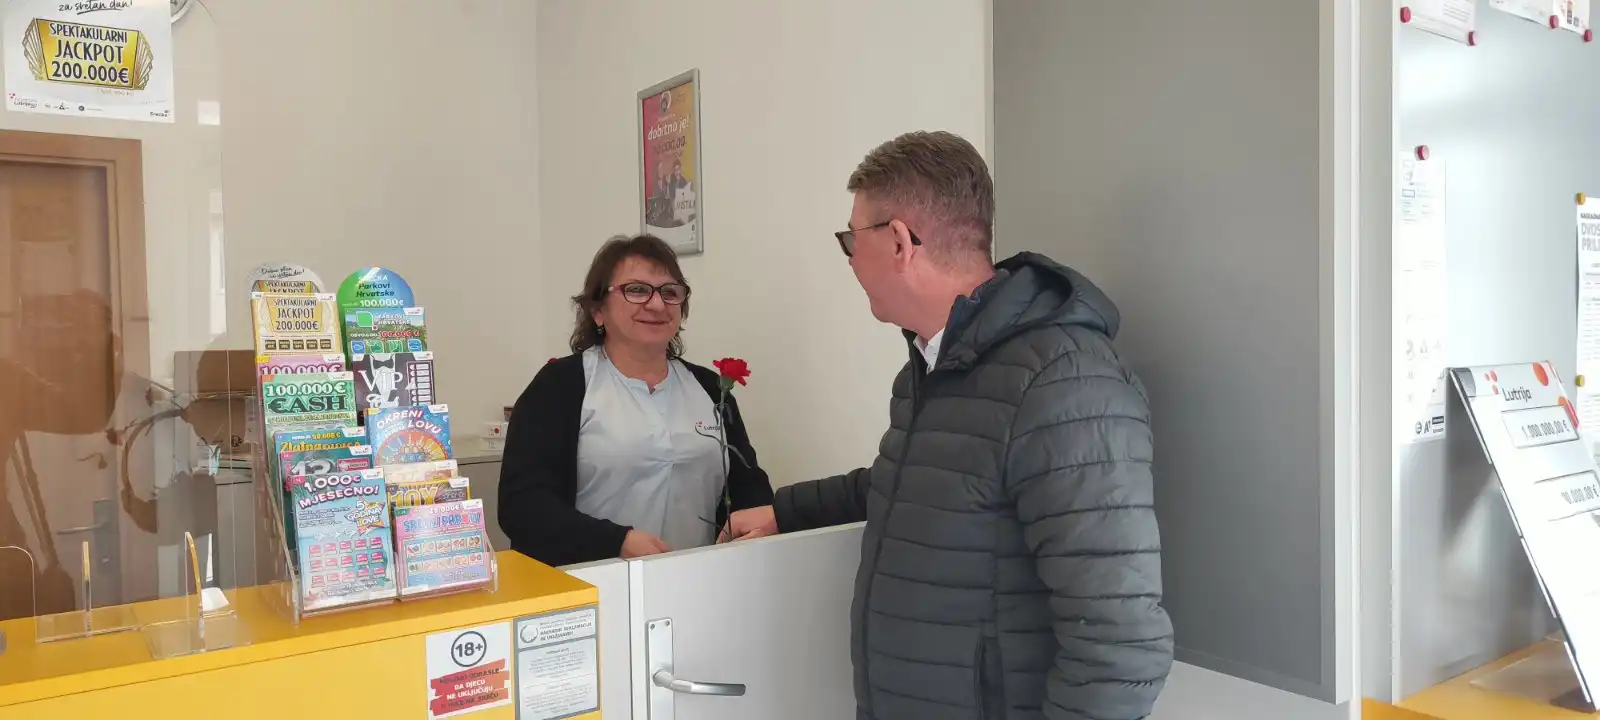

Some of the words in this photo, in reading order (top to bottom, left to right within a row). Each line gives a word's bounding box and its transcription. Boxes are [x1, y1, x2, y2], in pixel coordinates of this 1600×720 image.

[75, 0, 106, 10] sretan
[50, 22, 128, 43] SPEKTAKULARNI
[54, 41, 124, 64] JACKPOT
[51, 61, 129, 84] 200.000€
[648, 122, 678, 141] dobitno
[359, 281, 391, 290] Parkovi
[356, 290, 395, 298] Hrvatske
[360, 298, 404, 307] 100.000€
[277, 307, 315, 319] JACKPOT
[276, 320, 319, 331] 200.000€
[358, 370, 404, 392] VIP
[266, 381, 346, 397] 100.000€
[1501, 386, 1532, 403] Lutrija
[376, 409, 424, 430] OKRENI
[407, 419, 442, 434] LOVU
[356, 501, 365, 511] 5
[455, 641, 484, 658] 18+
[465, 679, 486, 689] DJECU
[446, 693, 457, 701] NE
